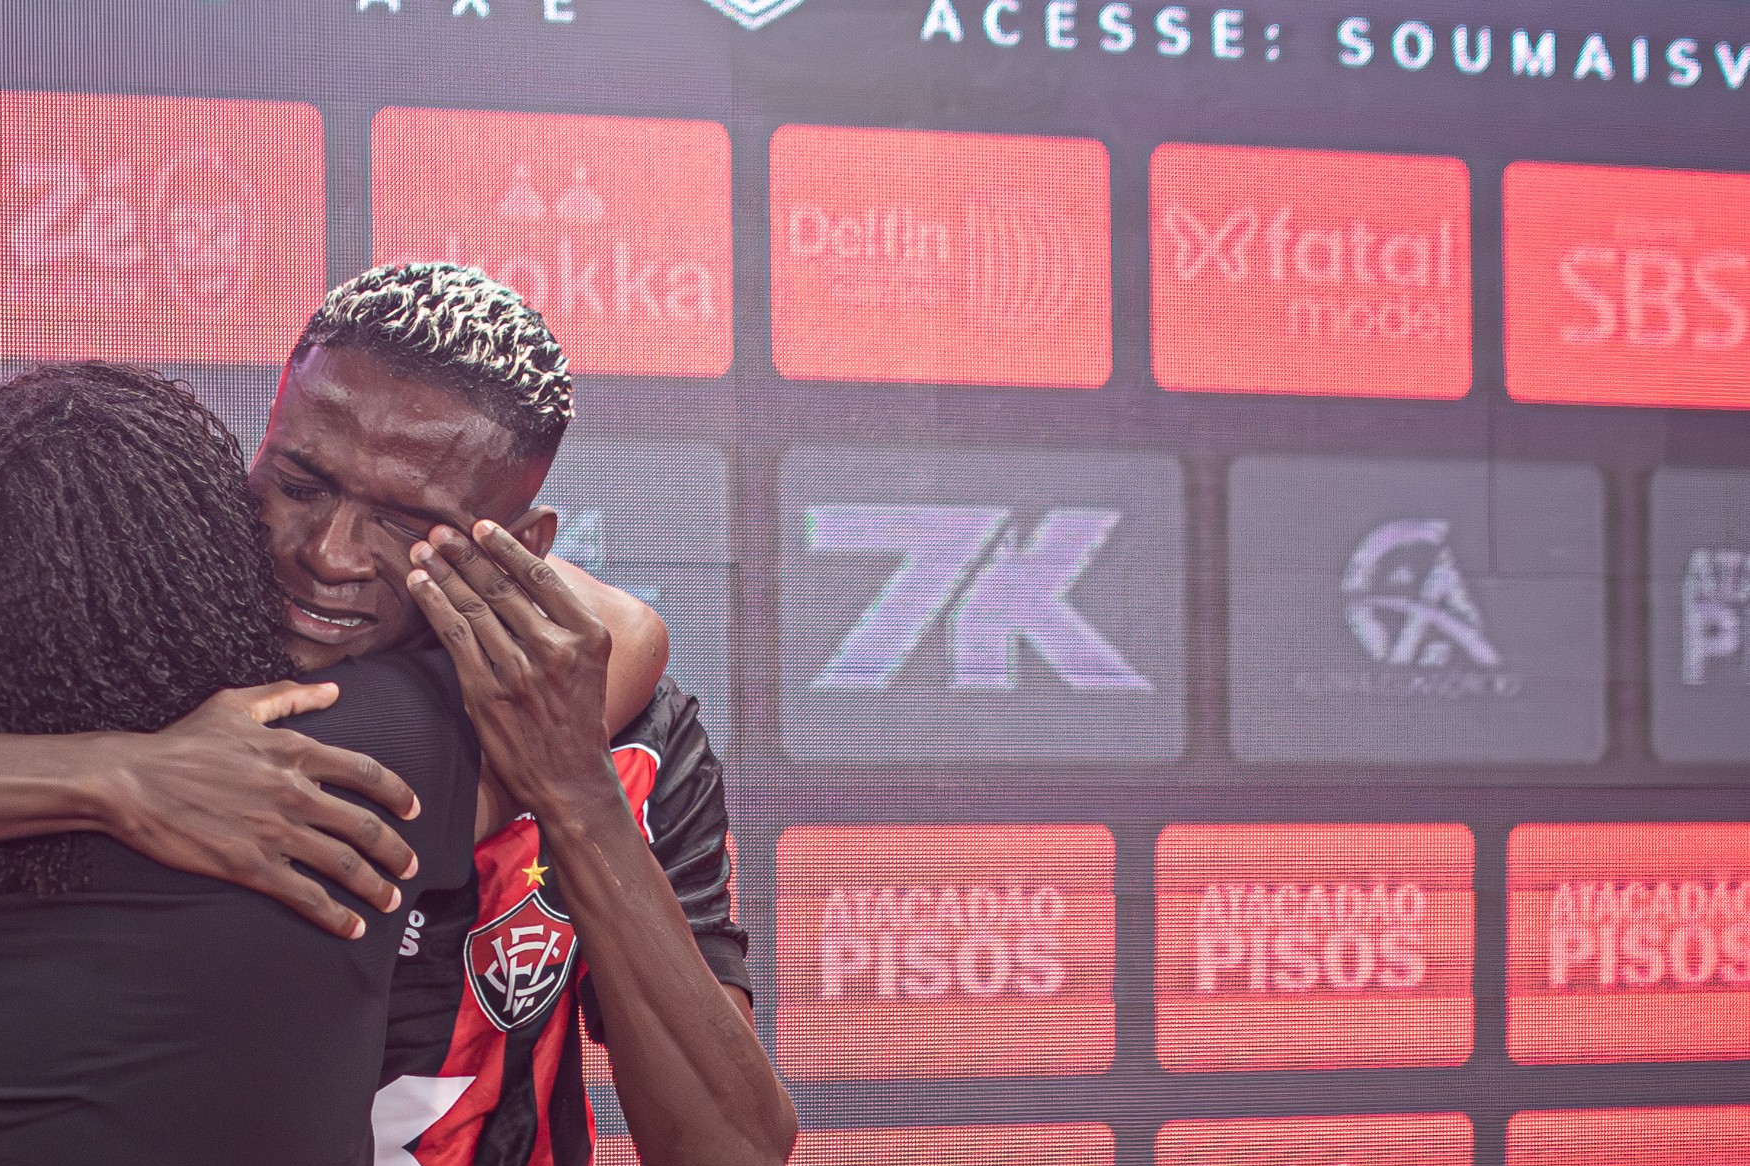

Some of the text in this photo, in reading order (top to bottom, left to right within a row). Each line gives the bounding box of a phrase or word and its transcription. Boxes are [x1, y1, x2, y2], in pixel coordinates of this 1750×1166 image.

[920, 0, 1281, 61] ACESSE:
[7, 158, 147, 268] Zé
[1263, 205, 1454, 288] fatal
[390, 235, 716, 322] okka
[807, 504, 1156, 694] 7K
[819, 932, 1067, 1000] PISOS
[1194, 926, 1427, 993] PISOS
